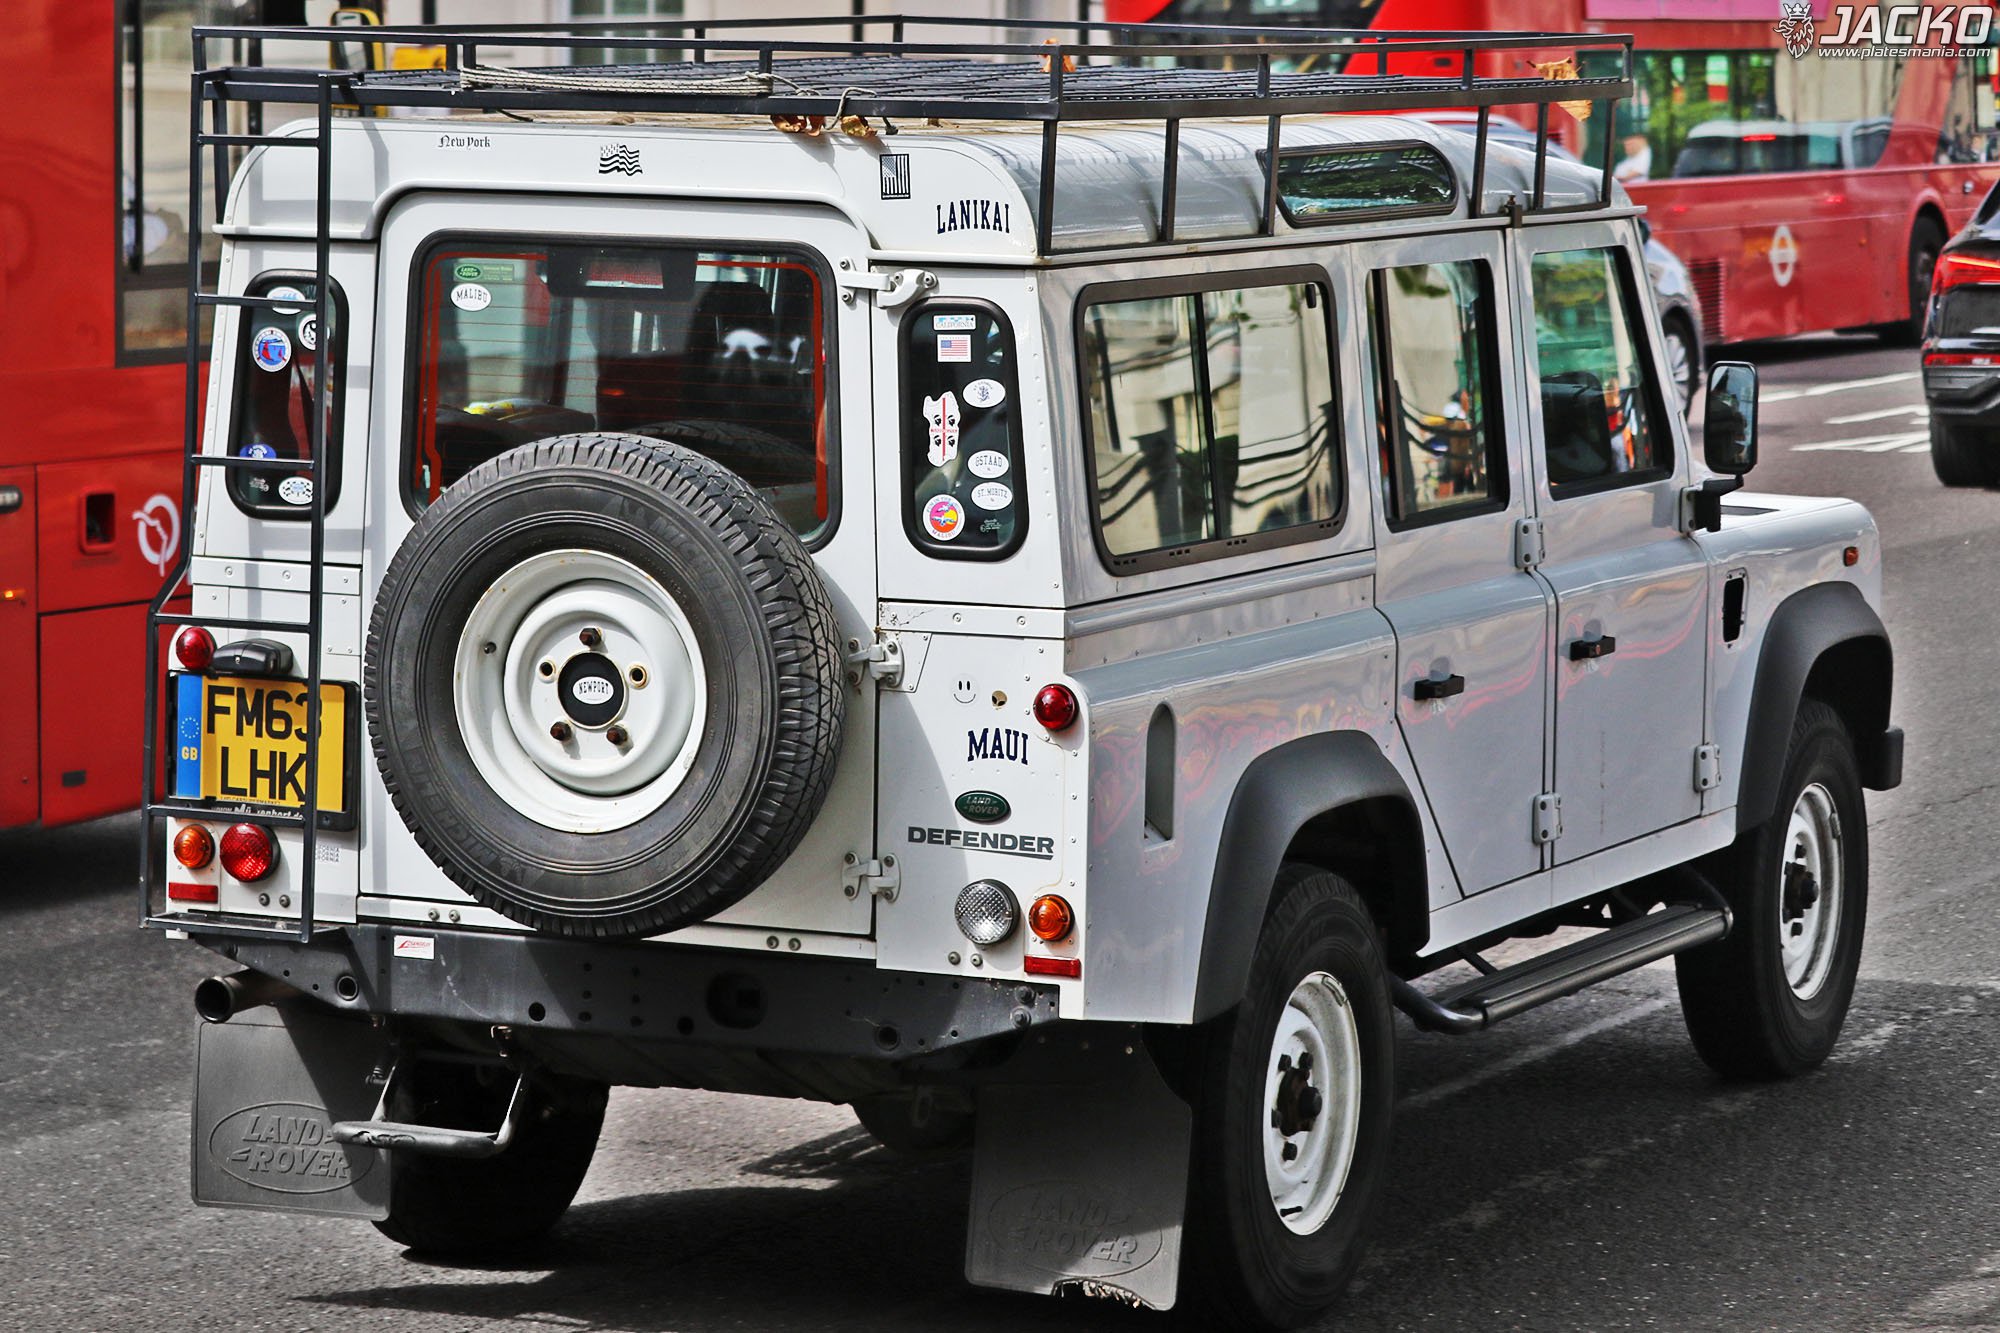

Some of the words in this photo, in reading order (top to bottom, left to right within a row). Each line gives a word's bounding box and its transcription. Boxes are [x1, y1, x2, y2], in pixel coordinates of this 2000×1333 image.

[438, 134, 465, 148] New
[467, 136, 491, 150] York
[936, 199, 1010, 235] LANIKAI
[456, 288, 488, 303] MALIBU
[578, 680, 609, 695] NEWPORT
[207, 684, 323, 742] FM63
[181, 746, 198, 761] GB
[967, 727, 1029, 765] MAUI
[220, 746, 308, 802] LHK
[966, 796, 991, 804] LAND
[968, 804, 999, 815] ROVER
[907, 826, 1055, 854] DEFENDER
[242, 1113, 324, 1147] LAND
[248, 1144, 352, 1179] ROVER
[1027, 1229, 1139, 1264] ROVER
